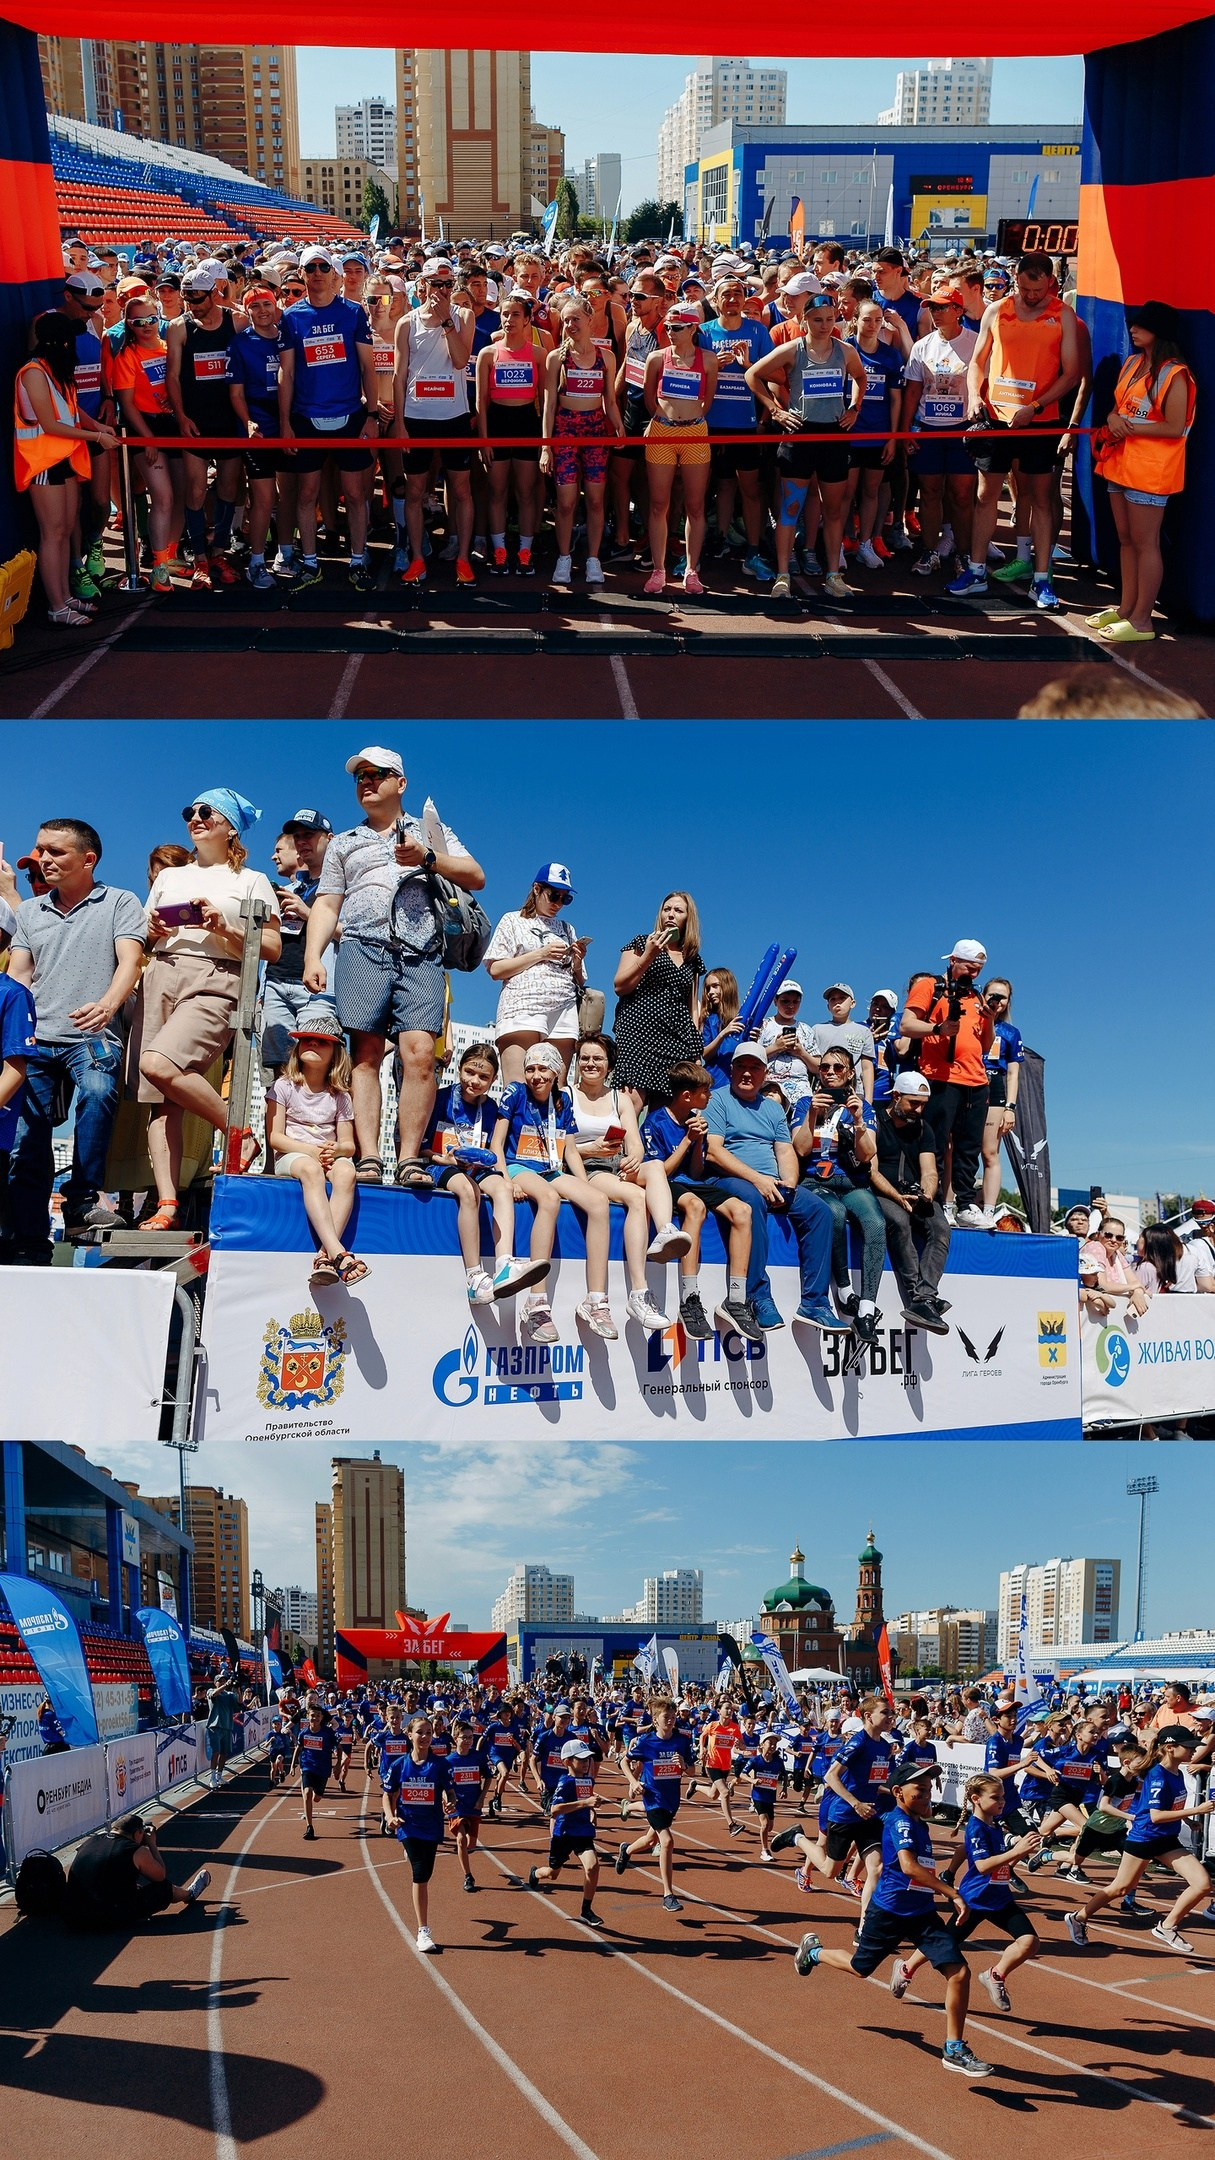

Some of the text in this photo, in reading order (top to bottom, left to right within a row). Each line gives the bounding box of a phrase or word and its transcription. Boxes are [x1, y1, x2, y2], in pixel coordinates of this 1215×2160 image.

[1042, 145, 1080, 156] ЦЕНТР
[322, 323, 335, 333] БЕГ
[315, 344, 335, 355] 653
[207, 360, 221, 370] 511
[503, 370, 525, 379] 1023
[576, 379, 594, 389] 222
[932, 403, 956, 412] 1069
[697, 1329, 766, 1363] ПСБ
[823, 1328, 918, 1378] ЗА БЕГ
[1137, 1338, 1215, 1365] ЖИВАЯ ВО
[485, 1344, 584, 1378] ГАЗПРОМ
[900, 1370, 918, 1390] .рф
[961, 1369, 1003, 1378] ЛИГА ГЕРОЕВ
[488, 1383, 579, 1402] НЕФТЬ
[642, 1379, 769, 1396] Генеральный спонсор
[265, 1419, 334, 1432] Правительство
[244, 1427, 351, 1441] Оренбургской области
[403, 1638, 445, 1655] ЗА БЕГ
[3, 1744, 44, 1767] ЕКСТИЛЬ
[175, 1754, 188, 1776] ПСБ
[658, 1765, 676, 1773] 2257
[37, 1778, 92, 1815] ОРЕНБУРГ МЕДИА
[407, 1789, 429, 1798] 2048
